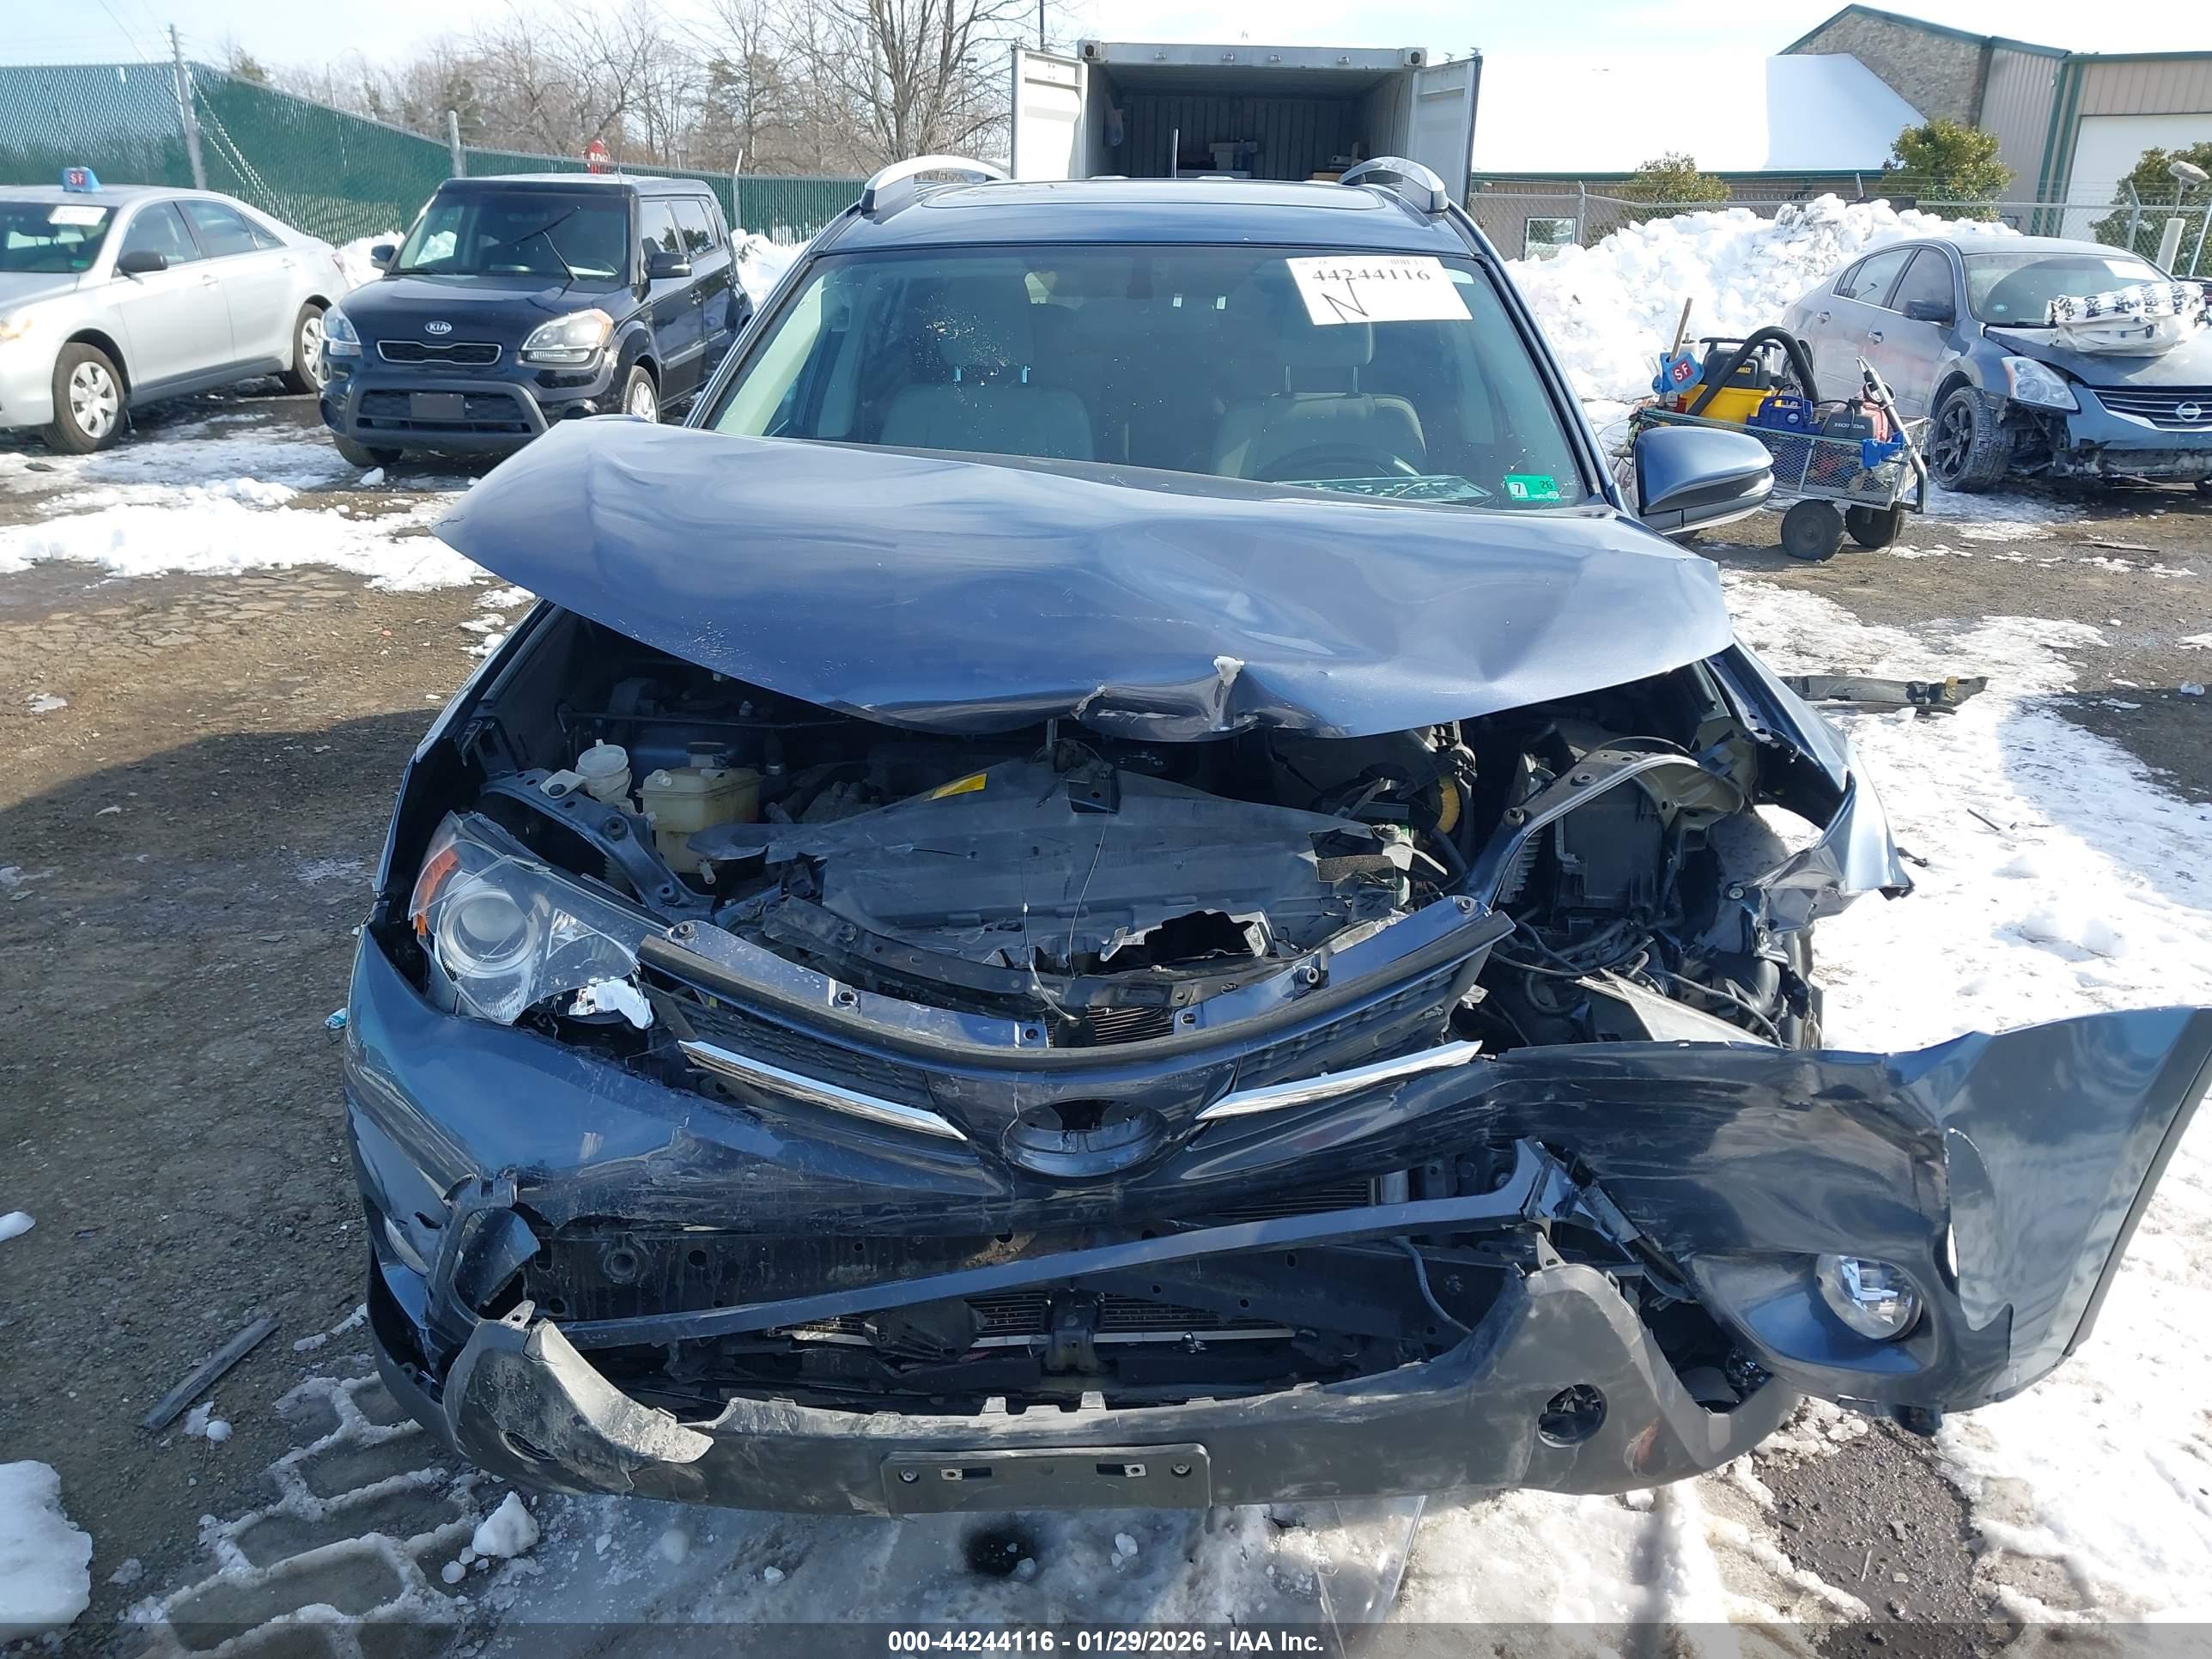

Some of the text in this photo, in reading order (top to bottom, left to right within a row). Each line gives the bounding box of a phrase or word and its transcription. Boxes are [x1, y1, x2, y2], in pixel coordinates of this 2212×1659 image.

[69, 173, 83, 185] SF
[1312, 268, 1431, 282] 44244116
[429, 323, 448, 331] KIA
[1674, 362, 1689, 380] SF
[1513, 483, 1522, 494] 7
[1539, 480, 1553, 489] 26
